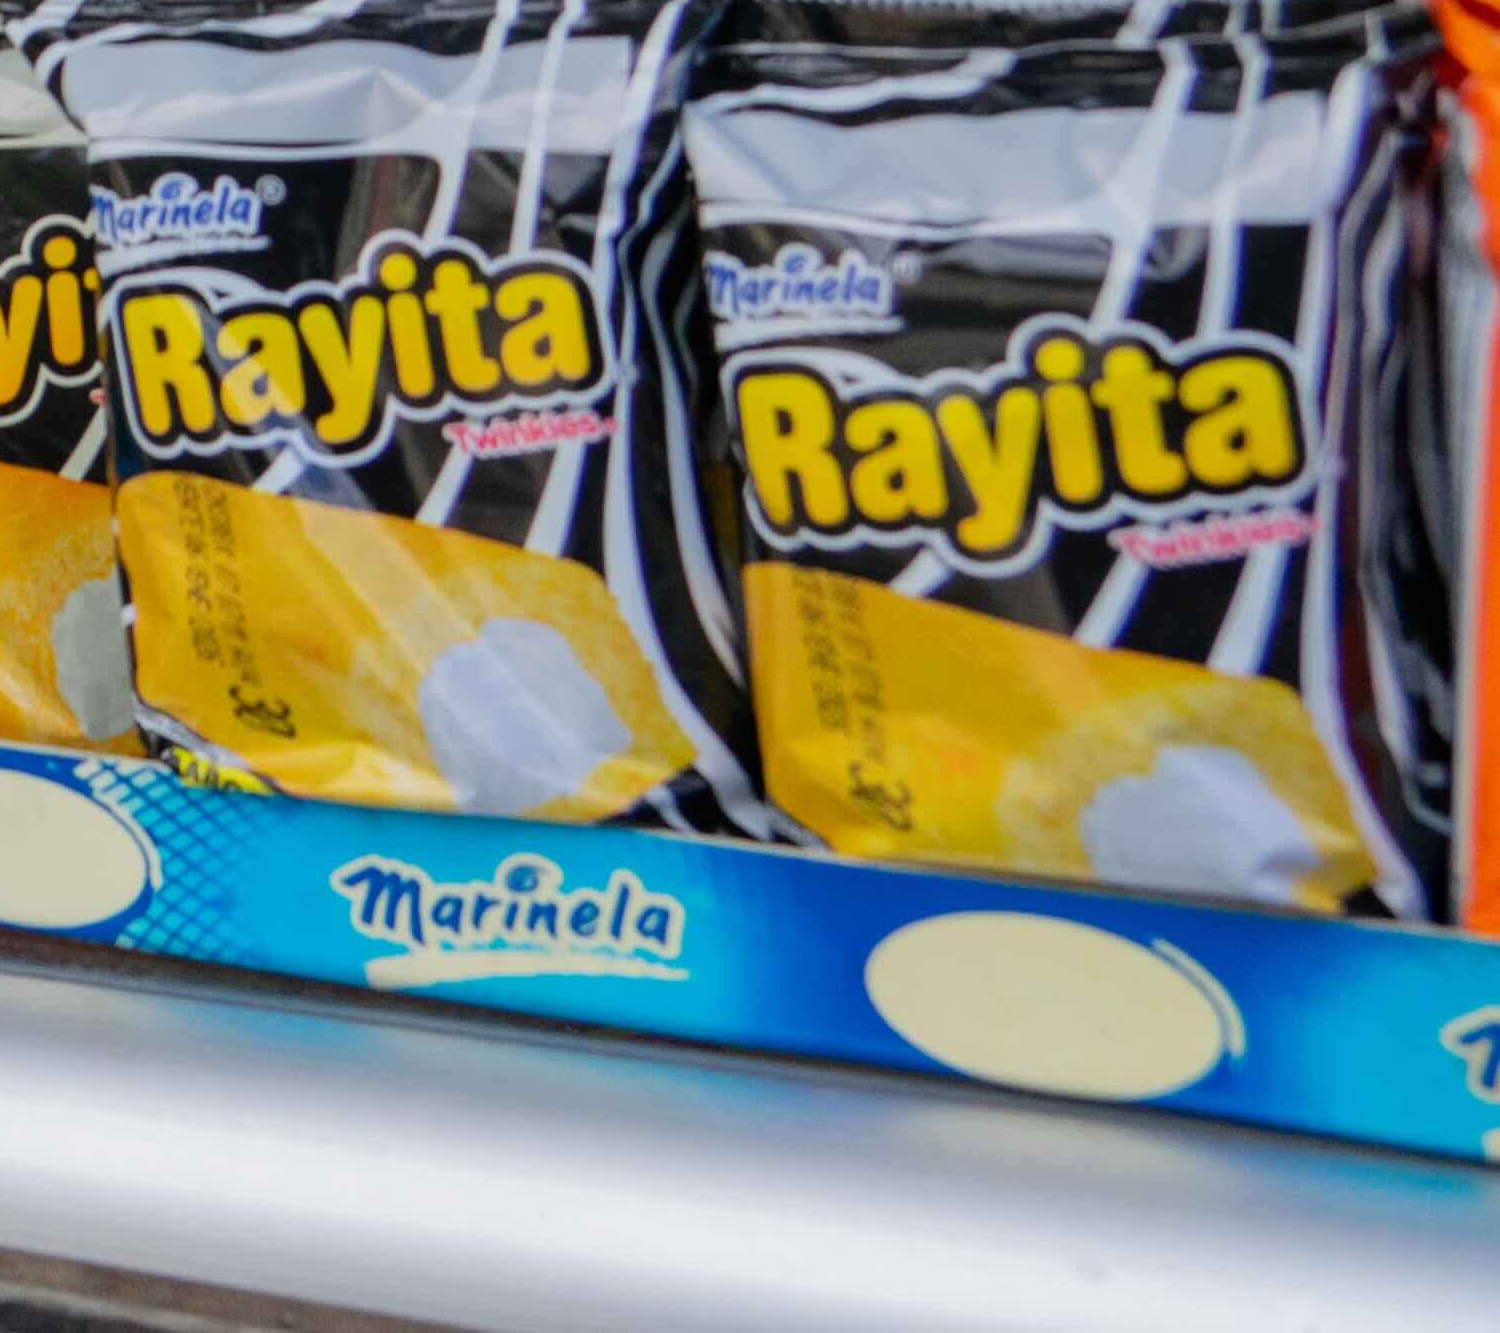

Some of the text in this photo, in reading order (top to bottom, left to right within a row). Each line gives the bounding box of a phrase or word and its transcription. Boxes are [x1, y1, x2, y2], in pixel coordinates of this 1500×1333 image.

[124, 253, 593, 445] Rayita
[710, 253, 882, 313] Marinela
[736, 336, 1297, 553] Rayita
[343, 863, 676, 946] Marinela
